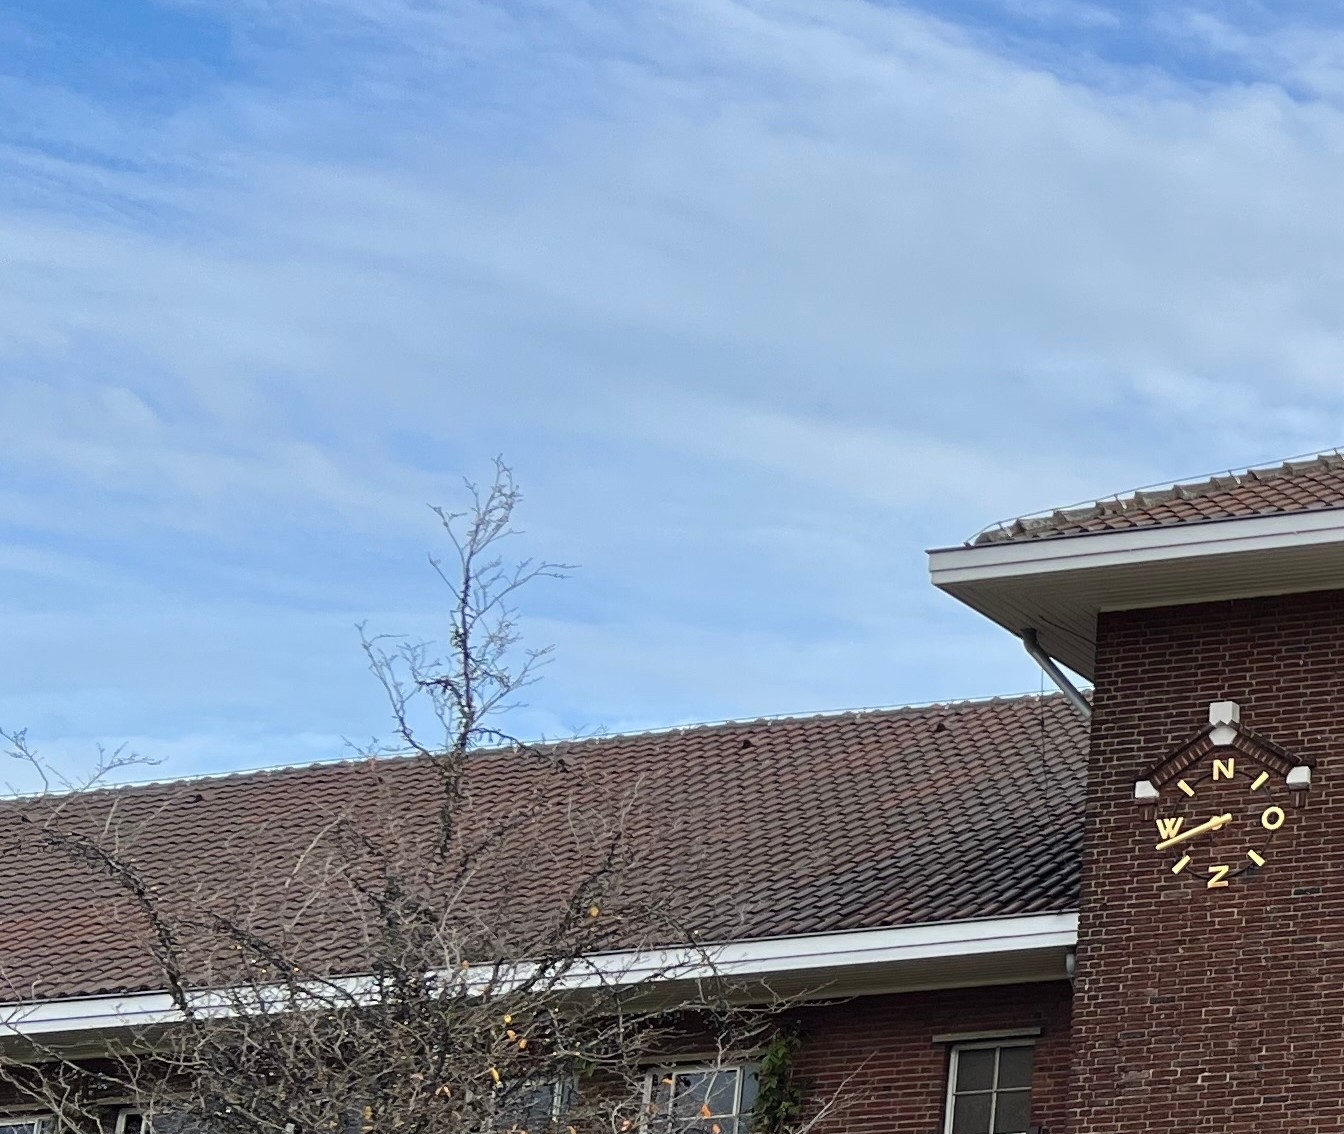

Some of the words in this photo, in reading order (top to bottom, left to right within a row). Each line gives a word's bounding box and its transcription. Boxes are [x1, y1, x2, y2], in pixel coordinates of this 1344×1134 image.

[1212, 758, 1235, 780] N
[1156, 816, 1184, 839] W
[1261, 806, 1285, 830] O
[1207, 865, 1229, 888] Z
